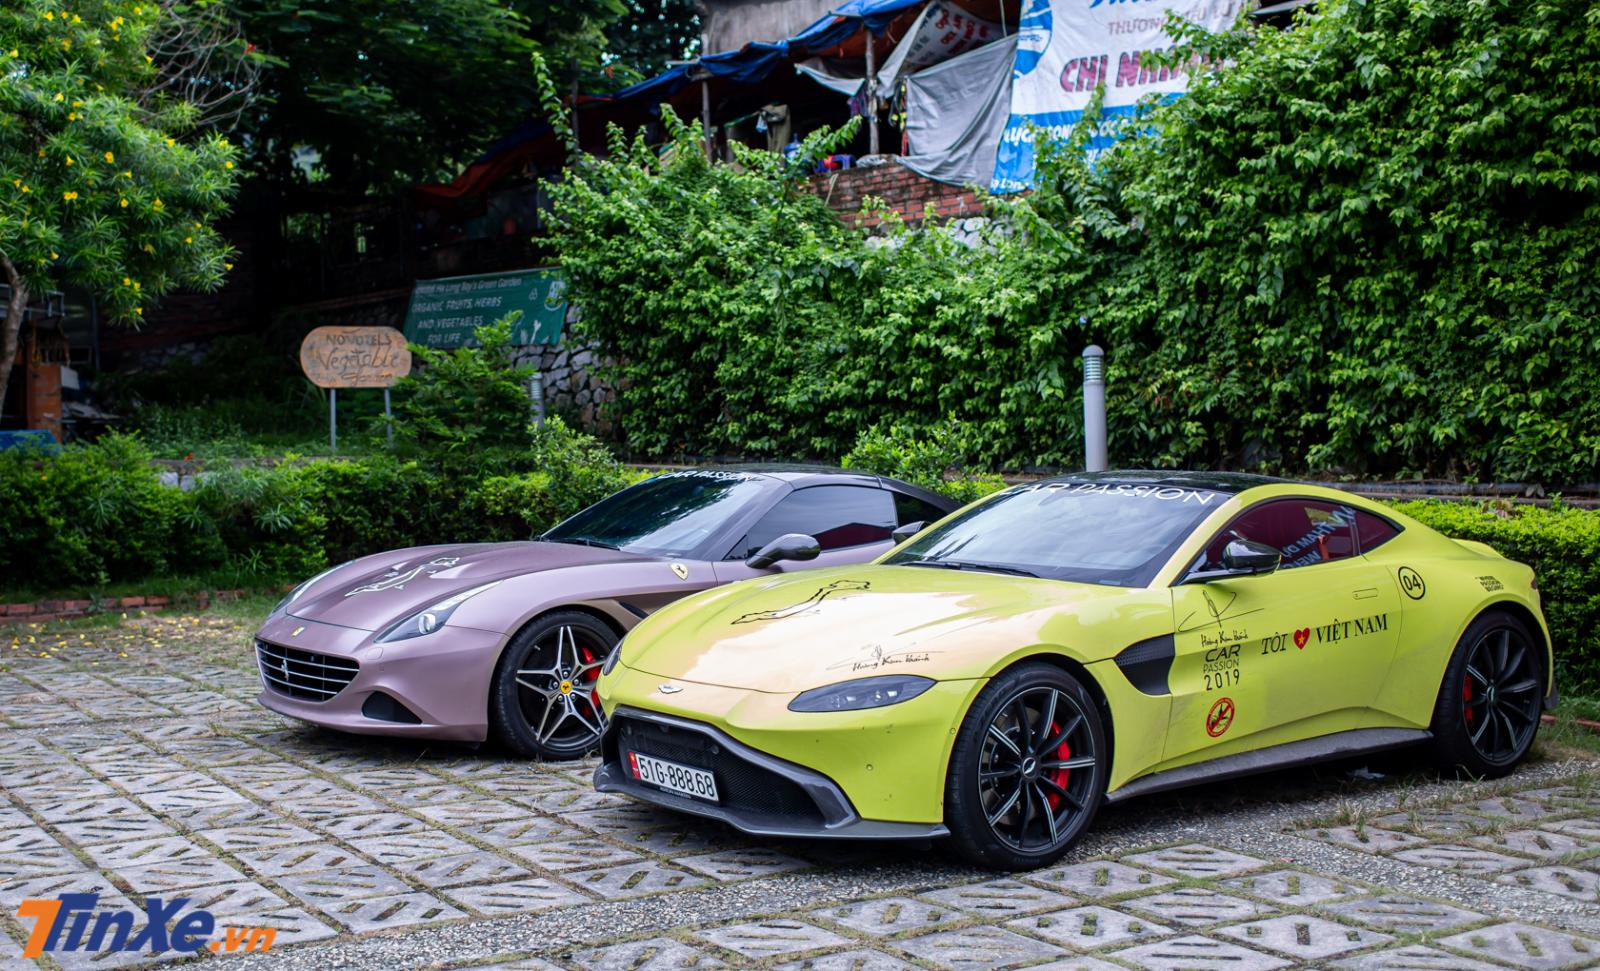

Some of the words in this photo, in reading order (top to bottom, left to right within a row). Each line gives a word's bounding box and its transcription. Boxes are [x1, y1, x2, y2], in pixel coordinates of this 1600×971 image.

[1059, 54, 1108, 93] CHI
[412, 301, 443, 313] ORGANIC
[474, 296, 502, 308] HERBS
[417, 319, 434, 329] AND
[437, 315, 484, 329] VEGETABLES
[427, 334, 442, 345] FOR
[444, 332, 461, 344] LIFE
[1071, 483, 1215, 505] PASSION
[1403, 574, 1421, 591] 04
[1261, 632, 1288, 655] TÔI
[1316, 618, 1351, 645] VIỆT
[1354, 613, 1387, 637] NAM
[1205, 644, 1241, 663] CAR
[1203, 658, 1239, 674] PASSION
[1204, 668, 1240, 691] 2019
[638, 757, 715, 798] 51G-888.68
